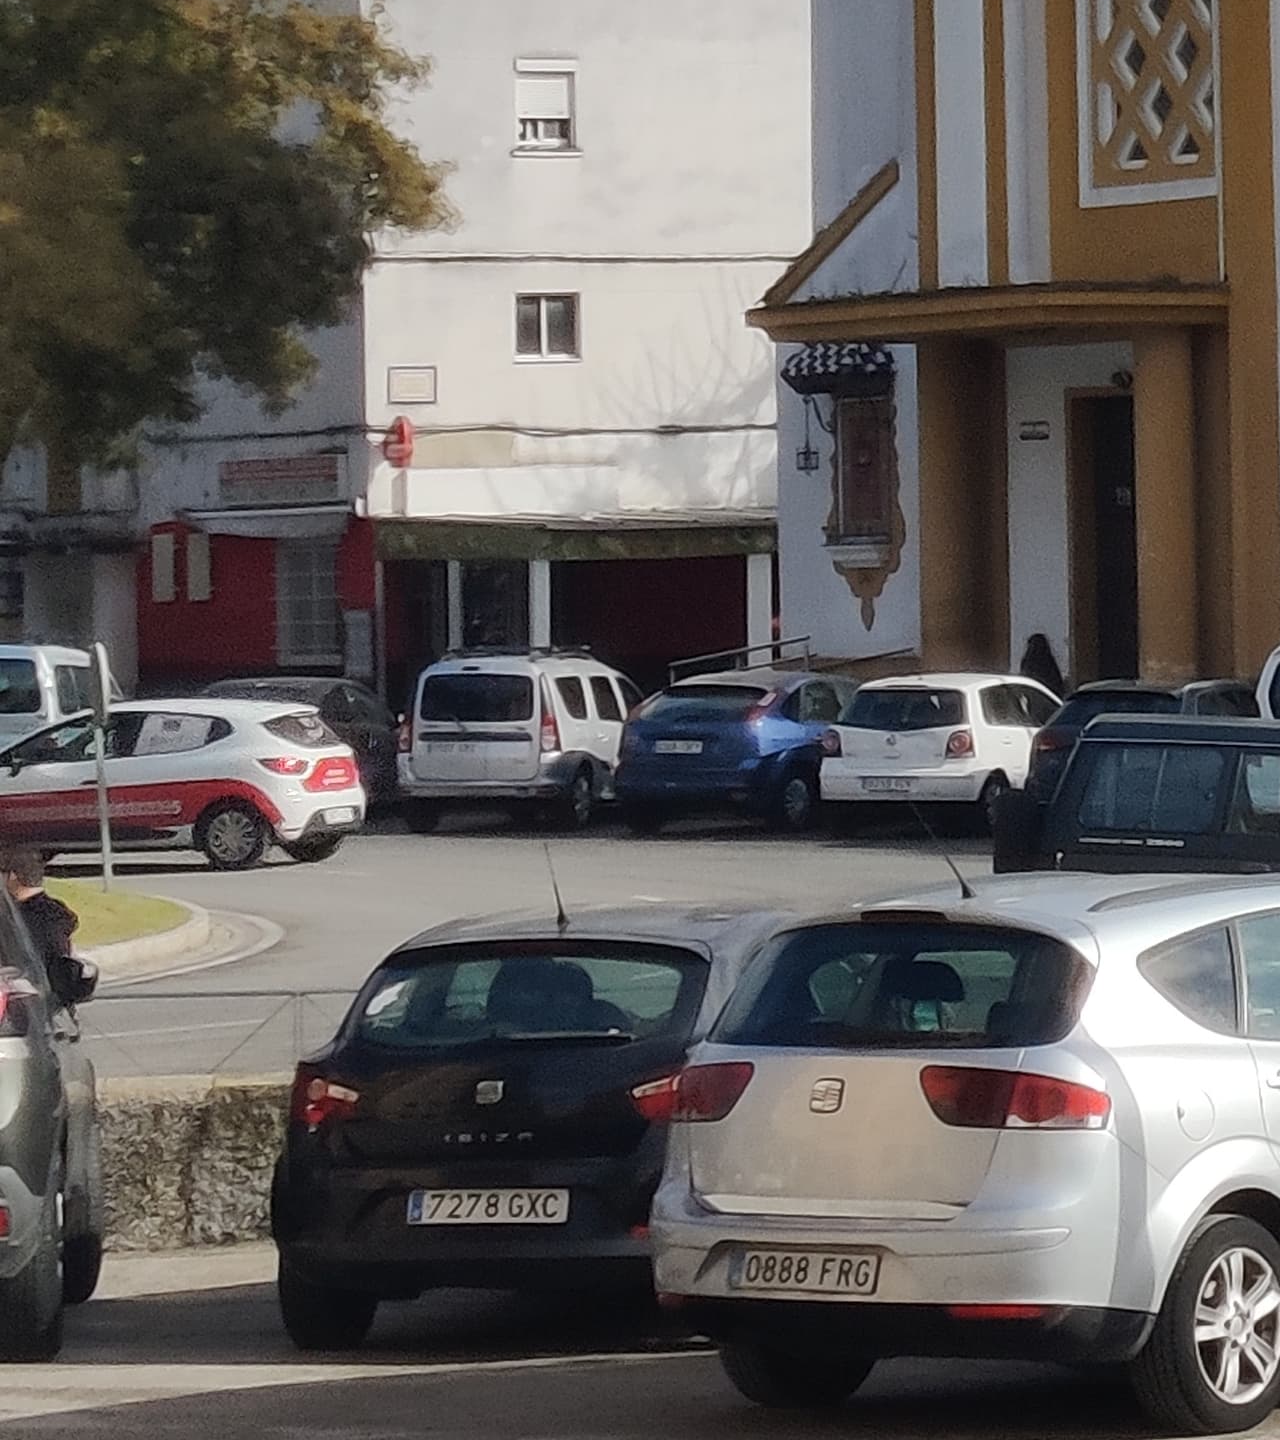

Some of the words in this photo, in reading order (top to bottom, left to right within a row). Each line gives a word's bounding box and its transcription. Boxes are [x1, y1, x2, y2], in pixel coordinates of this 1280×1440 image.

[427, 1193, 499, 1219] 7278
[508, 1193, 558, 1219] GXC
[745, 1254, 809, 1285] 0888
[819, 1257, 870, 1289] FRG
